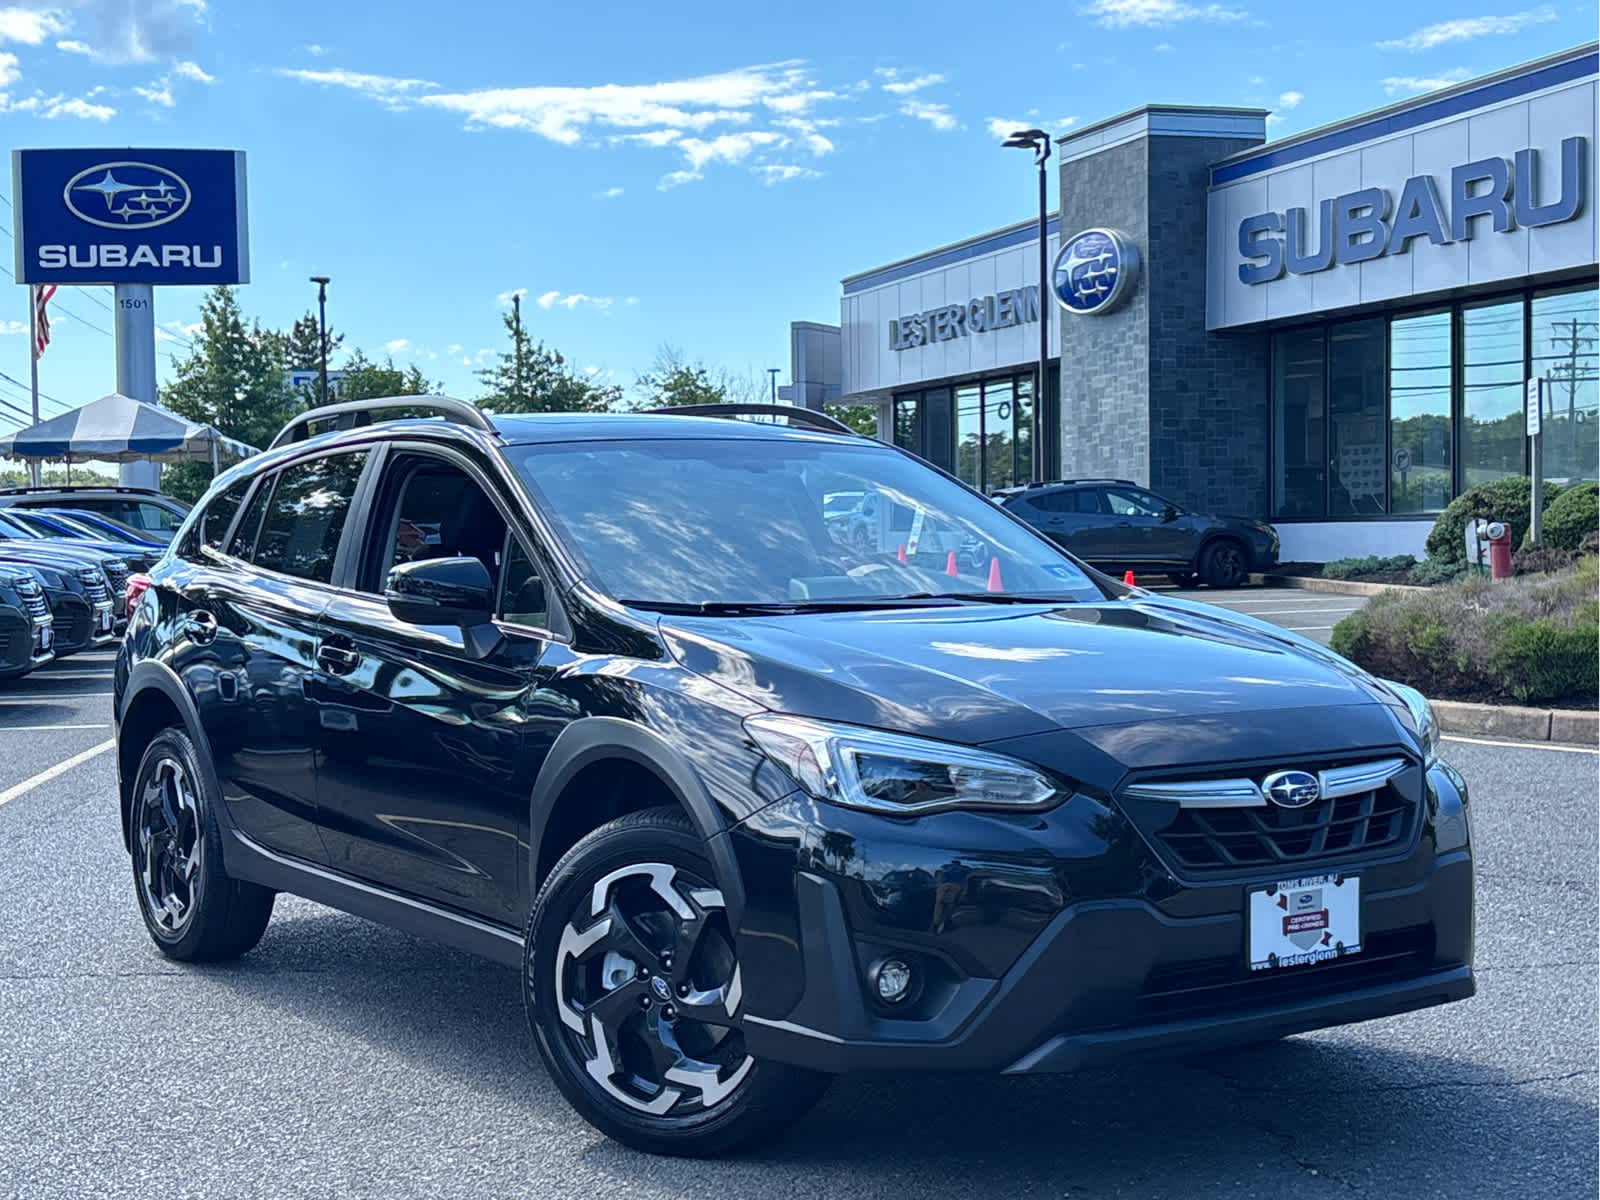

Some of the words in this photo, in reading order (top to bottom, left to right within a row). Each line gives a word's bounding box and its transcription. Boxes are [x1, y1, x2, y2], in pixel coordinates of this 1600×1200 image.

[1238, 136, 1587, 286] SUBARU
[38, 244, 222, 268] SUBARU
[119, 299, 148, 310] 1501
[889, 303, 967, 351] LESTER
[967, 284, 1041, 334] GLENN
